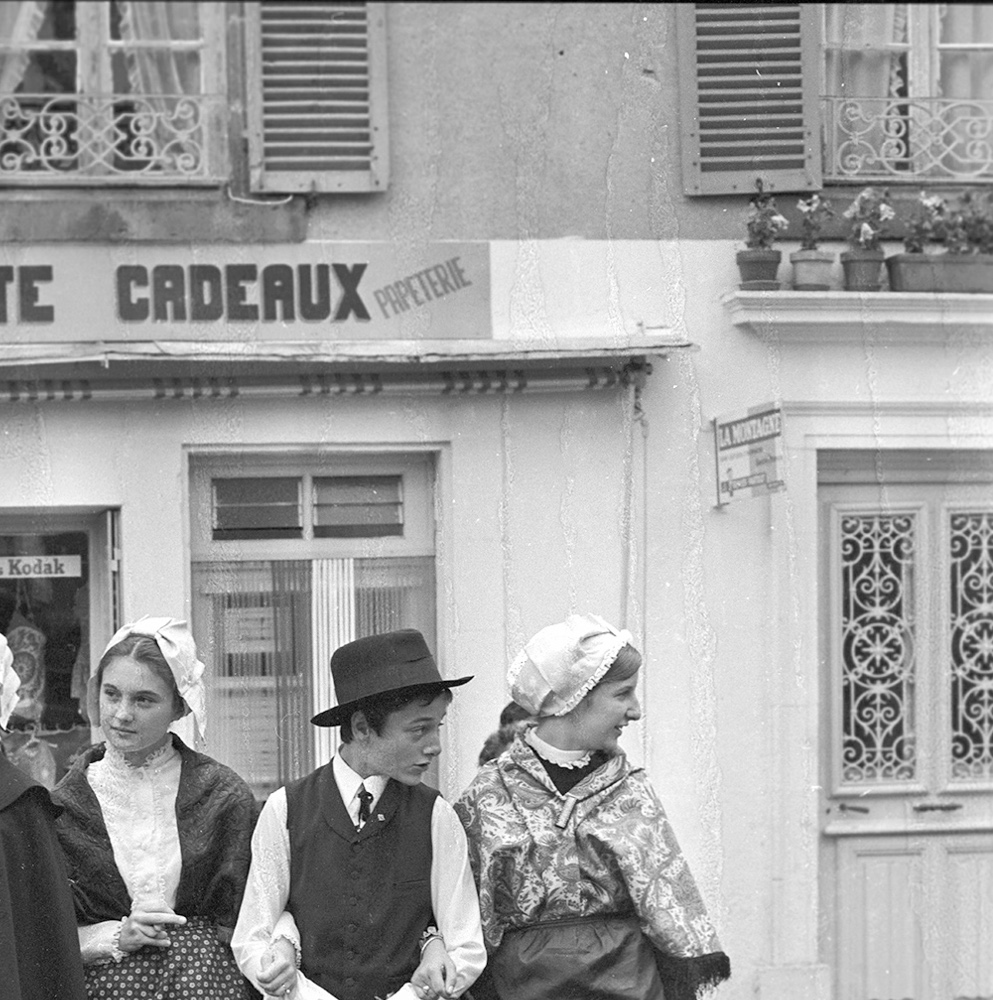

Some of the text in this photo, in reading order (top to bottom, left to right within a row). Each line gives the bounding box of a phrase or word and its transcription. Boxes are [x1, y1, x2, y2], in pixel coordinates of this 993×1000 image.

[116, 263, 372, 322] CADEAUX
[373, 256, 473, 319] PAPETERIE
[8, 558, 65, 576] Kodak
